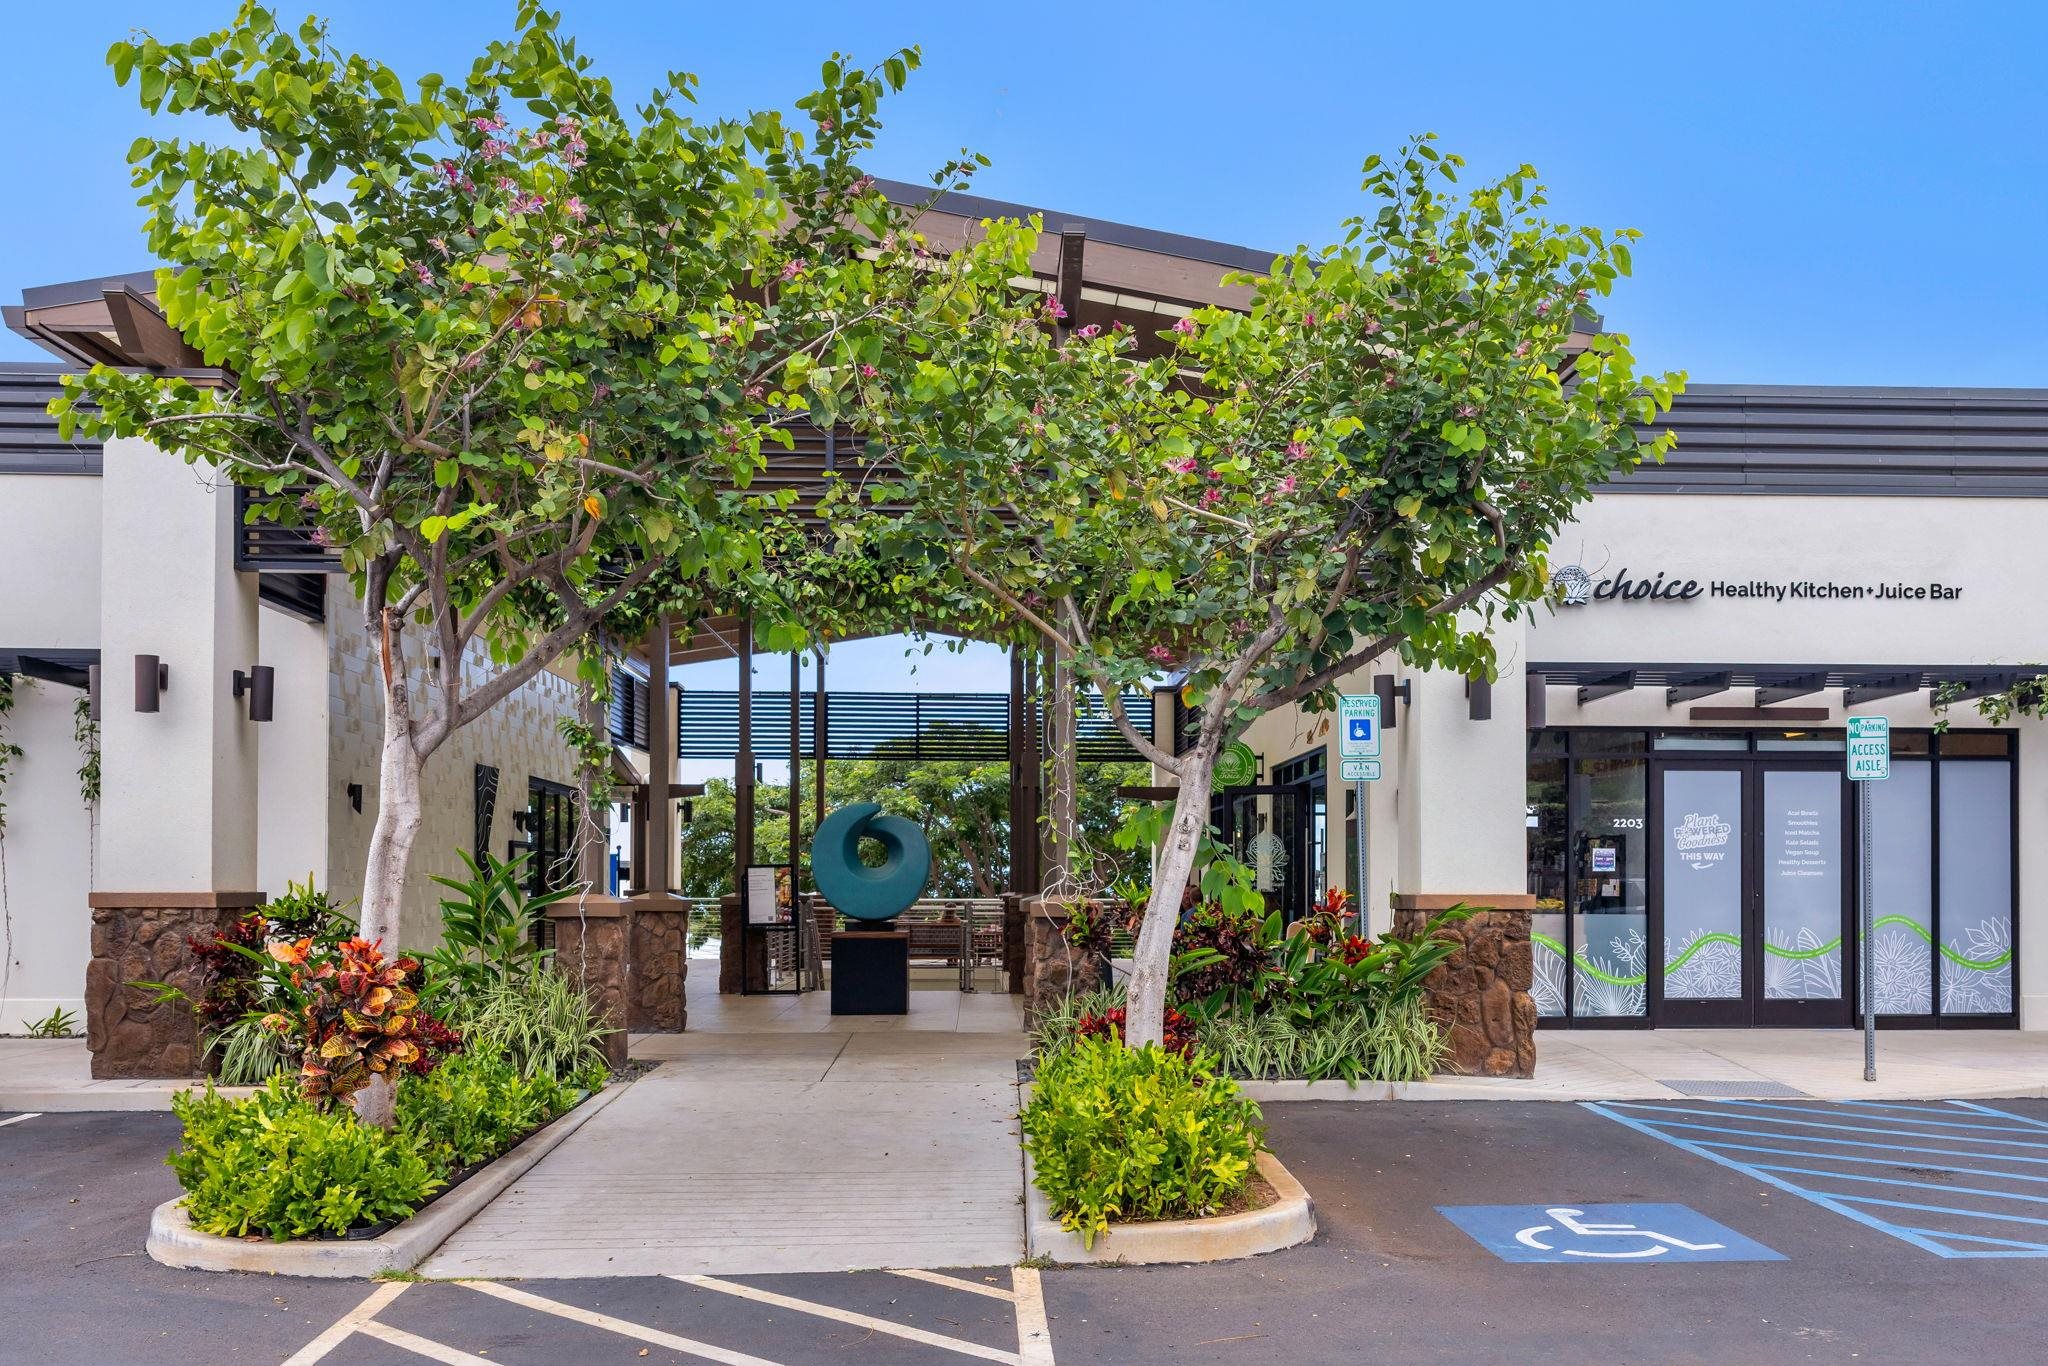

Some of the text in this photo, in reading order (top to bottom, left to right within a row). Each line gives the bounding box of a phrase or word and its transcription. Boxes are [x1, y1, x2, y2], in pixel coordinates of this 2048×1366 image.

[1593, 568, 1704, 600] choice
[1710, 581, 1786, 602] Healthy
[1930, 583, 1962, 600] Bar
[1342, 699, 1377, 708] RESERVED
[1344, 709, 1375, 717] PARKING
[1849, 722, 1885, 734] NO PARKING
[1851, 743, 1886, 756] ACCESS
[1855, 760, 1881, 771] AISLE
[1613, 818, 1644, 830] 2203
[1684, 812, 1719, 829] Plant
[1677, 833, 1728, 850] Goodness
[1680, 852, 1725, 861] THIS WAY
